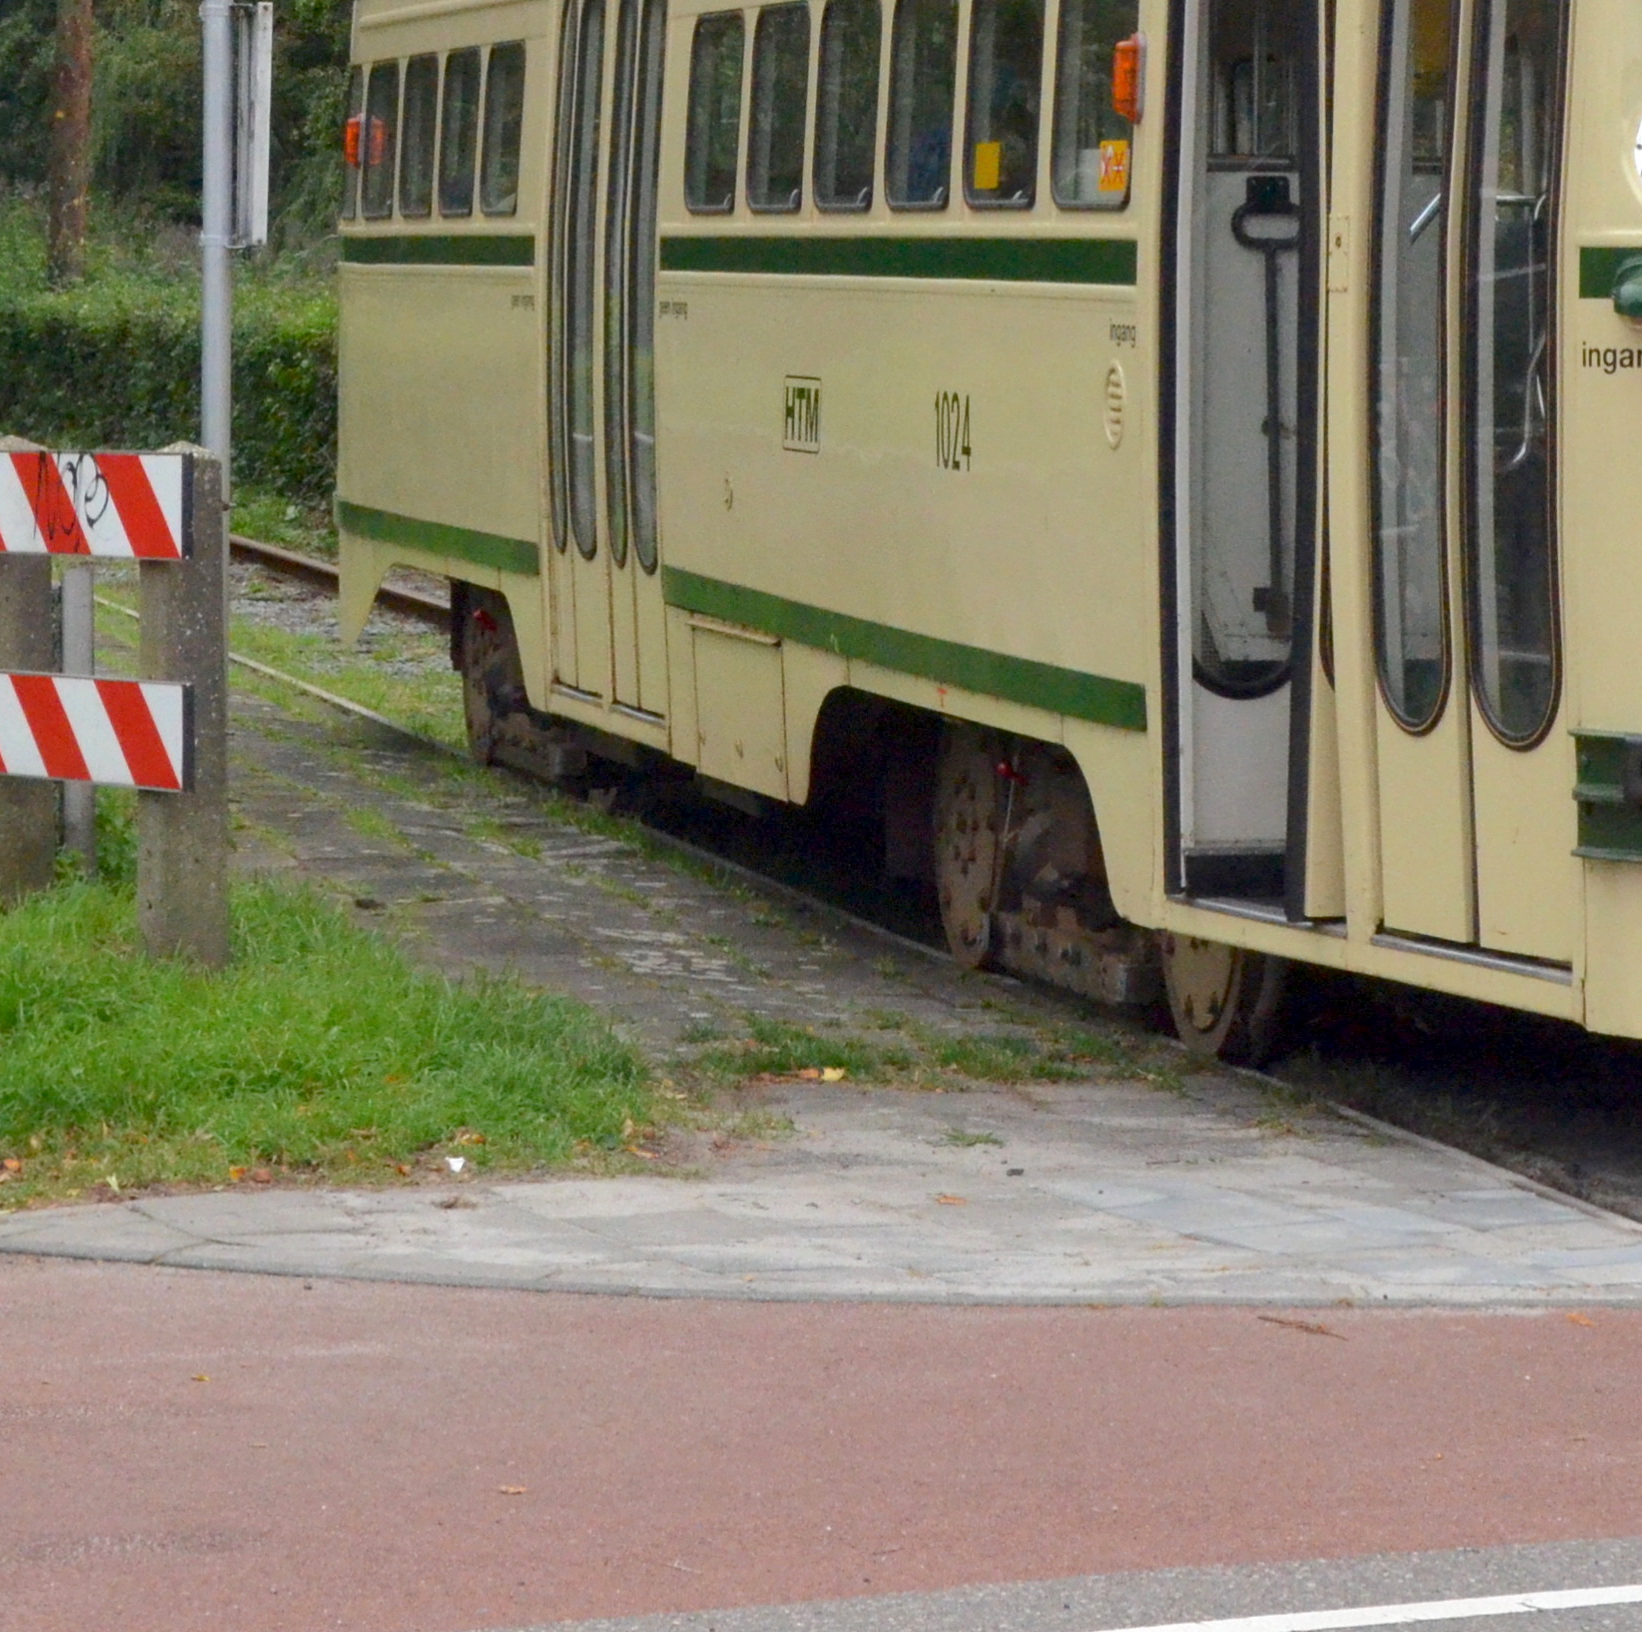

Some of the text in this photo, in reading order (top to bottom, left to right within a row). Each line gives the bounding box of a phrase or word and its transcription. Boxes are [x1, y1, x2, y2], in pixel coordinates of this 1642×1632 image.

[1109, 320, 1137, 347] ingang
[784, 387, 820, 444] HTM
[934, 391, 972, 471] 1024
